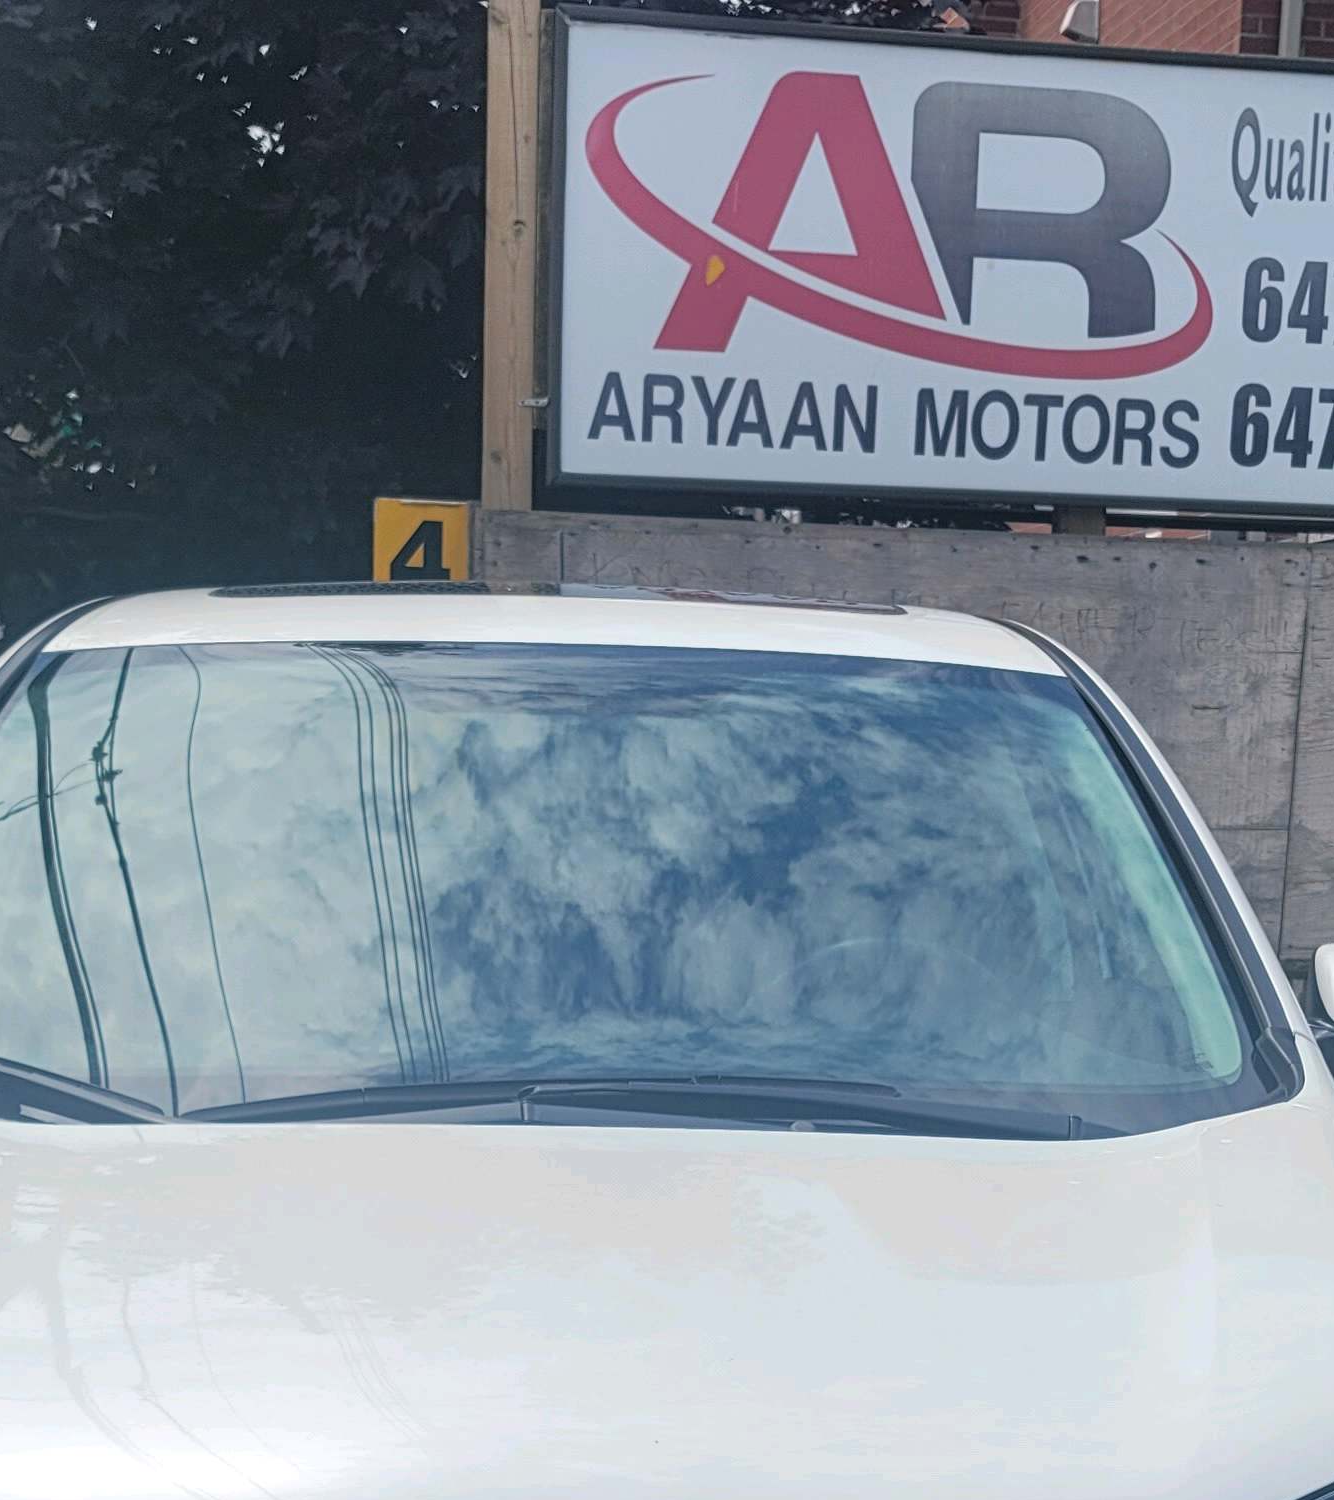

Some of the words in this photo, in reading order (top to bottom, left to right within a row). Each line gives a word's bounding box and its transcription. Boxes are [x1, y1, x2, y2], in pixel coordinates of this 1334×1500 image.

[586, 370, 879, 455] ARYAAN
[912, 386, 1202, 470] MOTORS
[390, 520, 451, 580] 4
